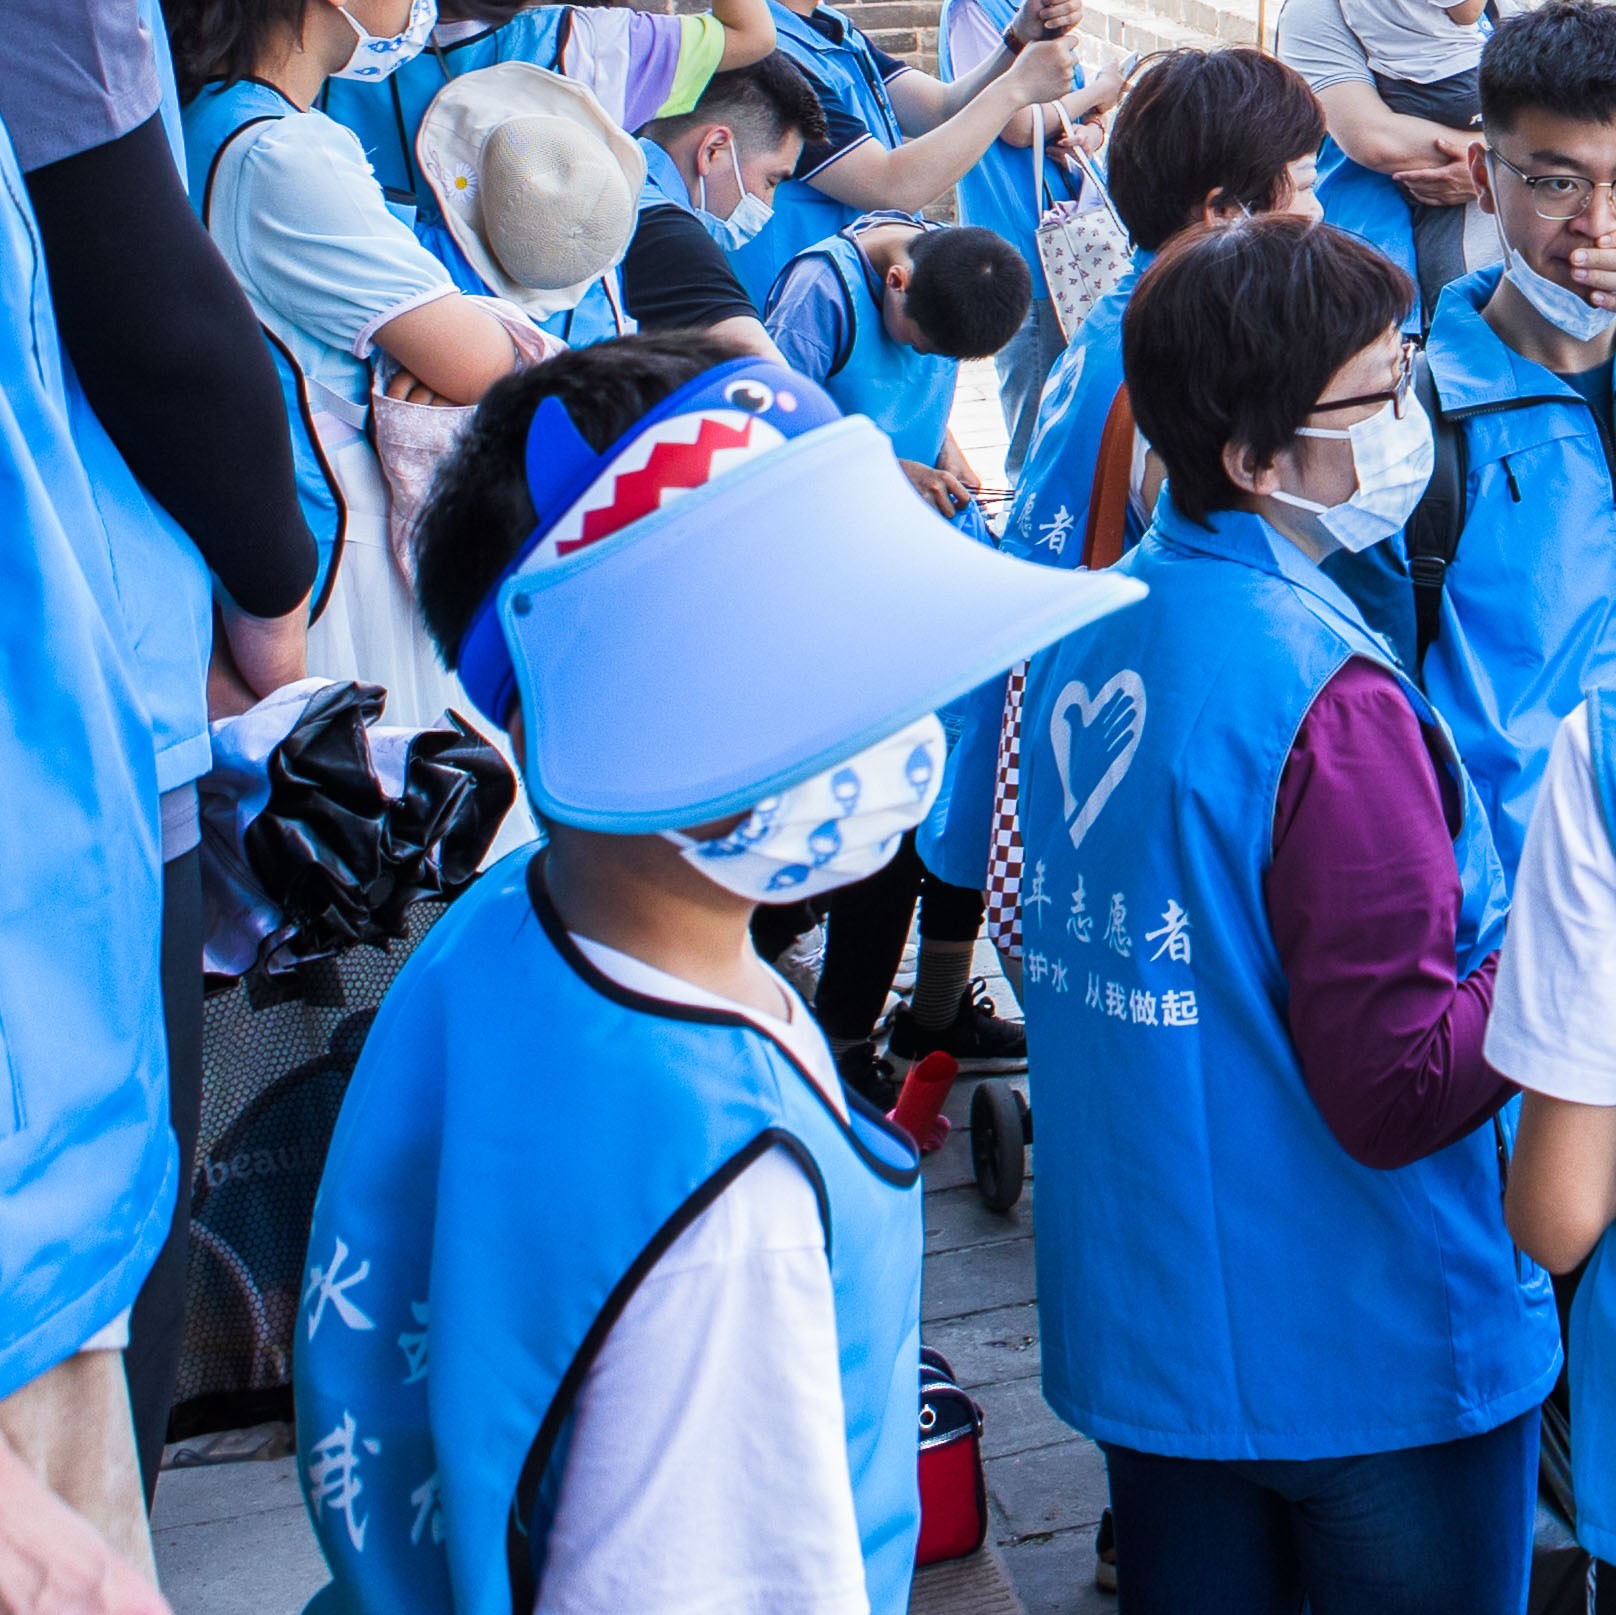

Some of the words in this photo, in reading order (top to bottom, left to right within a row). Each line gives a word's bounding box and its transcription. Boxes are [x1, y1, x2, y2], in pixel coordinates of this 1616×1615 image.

[1022, 947, 1069, 994] 护水
[1084, 970, 1200, 1027] 从我做起
